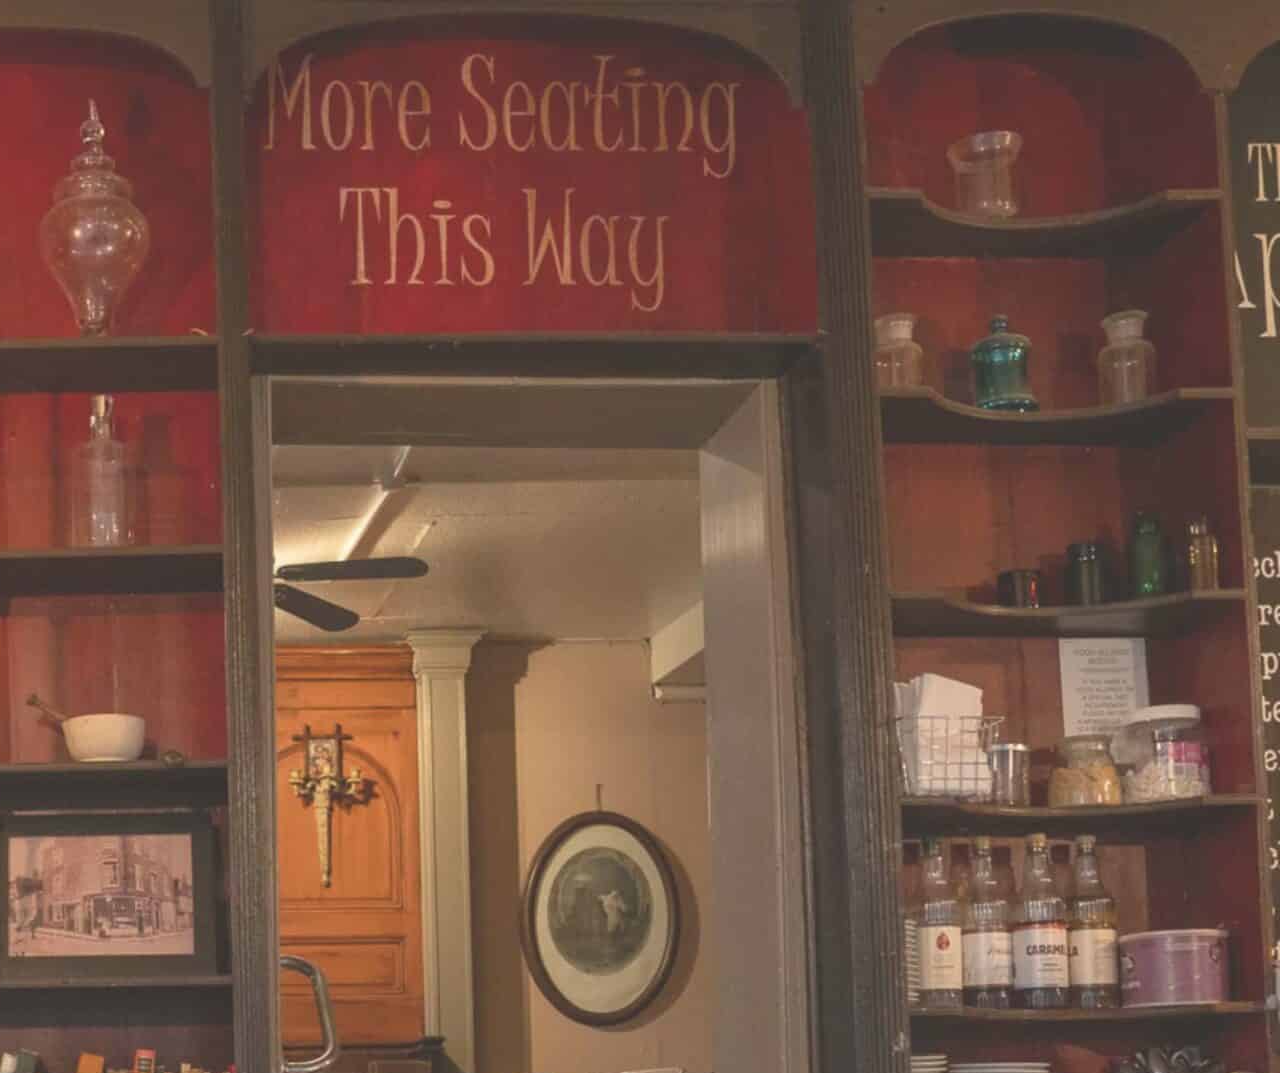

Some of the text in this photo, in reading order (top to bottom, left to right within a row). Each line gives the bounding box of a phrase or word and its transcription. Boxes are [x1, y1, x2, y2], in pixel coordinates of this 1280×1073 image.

[263, 52, 741, 178] More Seating
[1247, 142, 1280, 202] T
[339, 186, 670, 311] This Way
